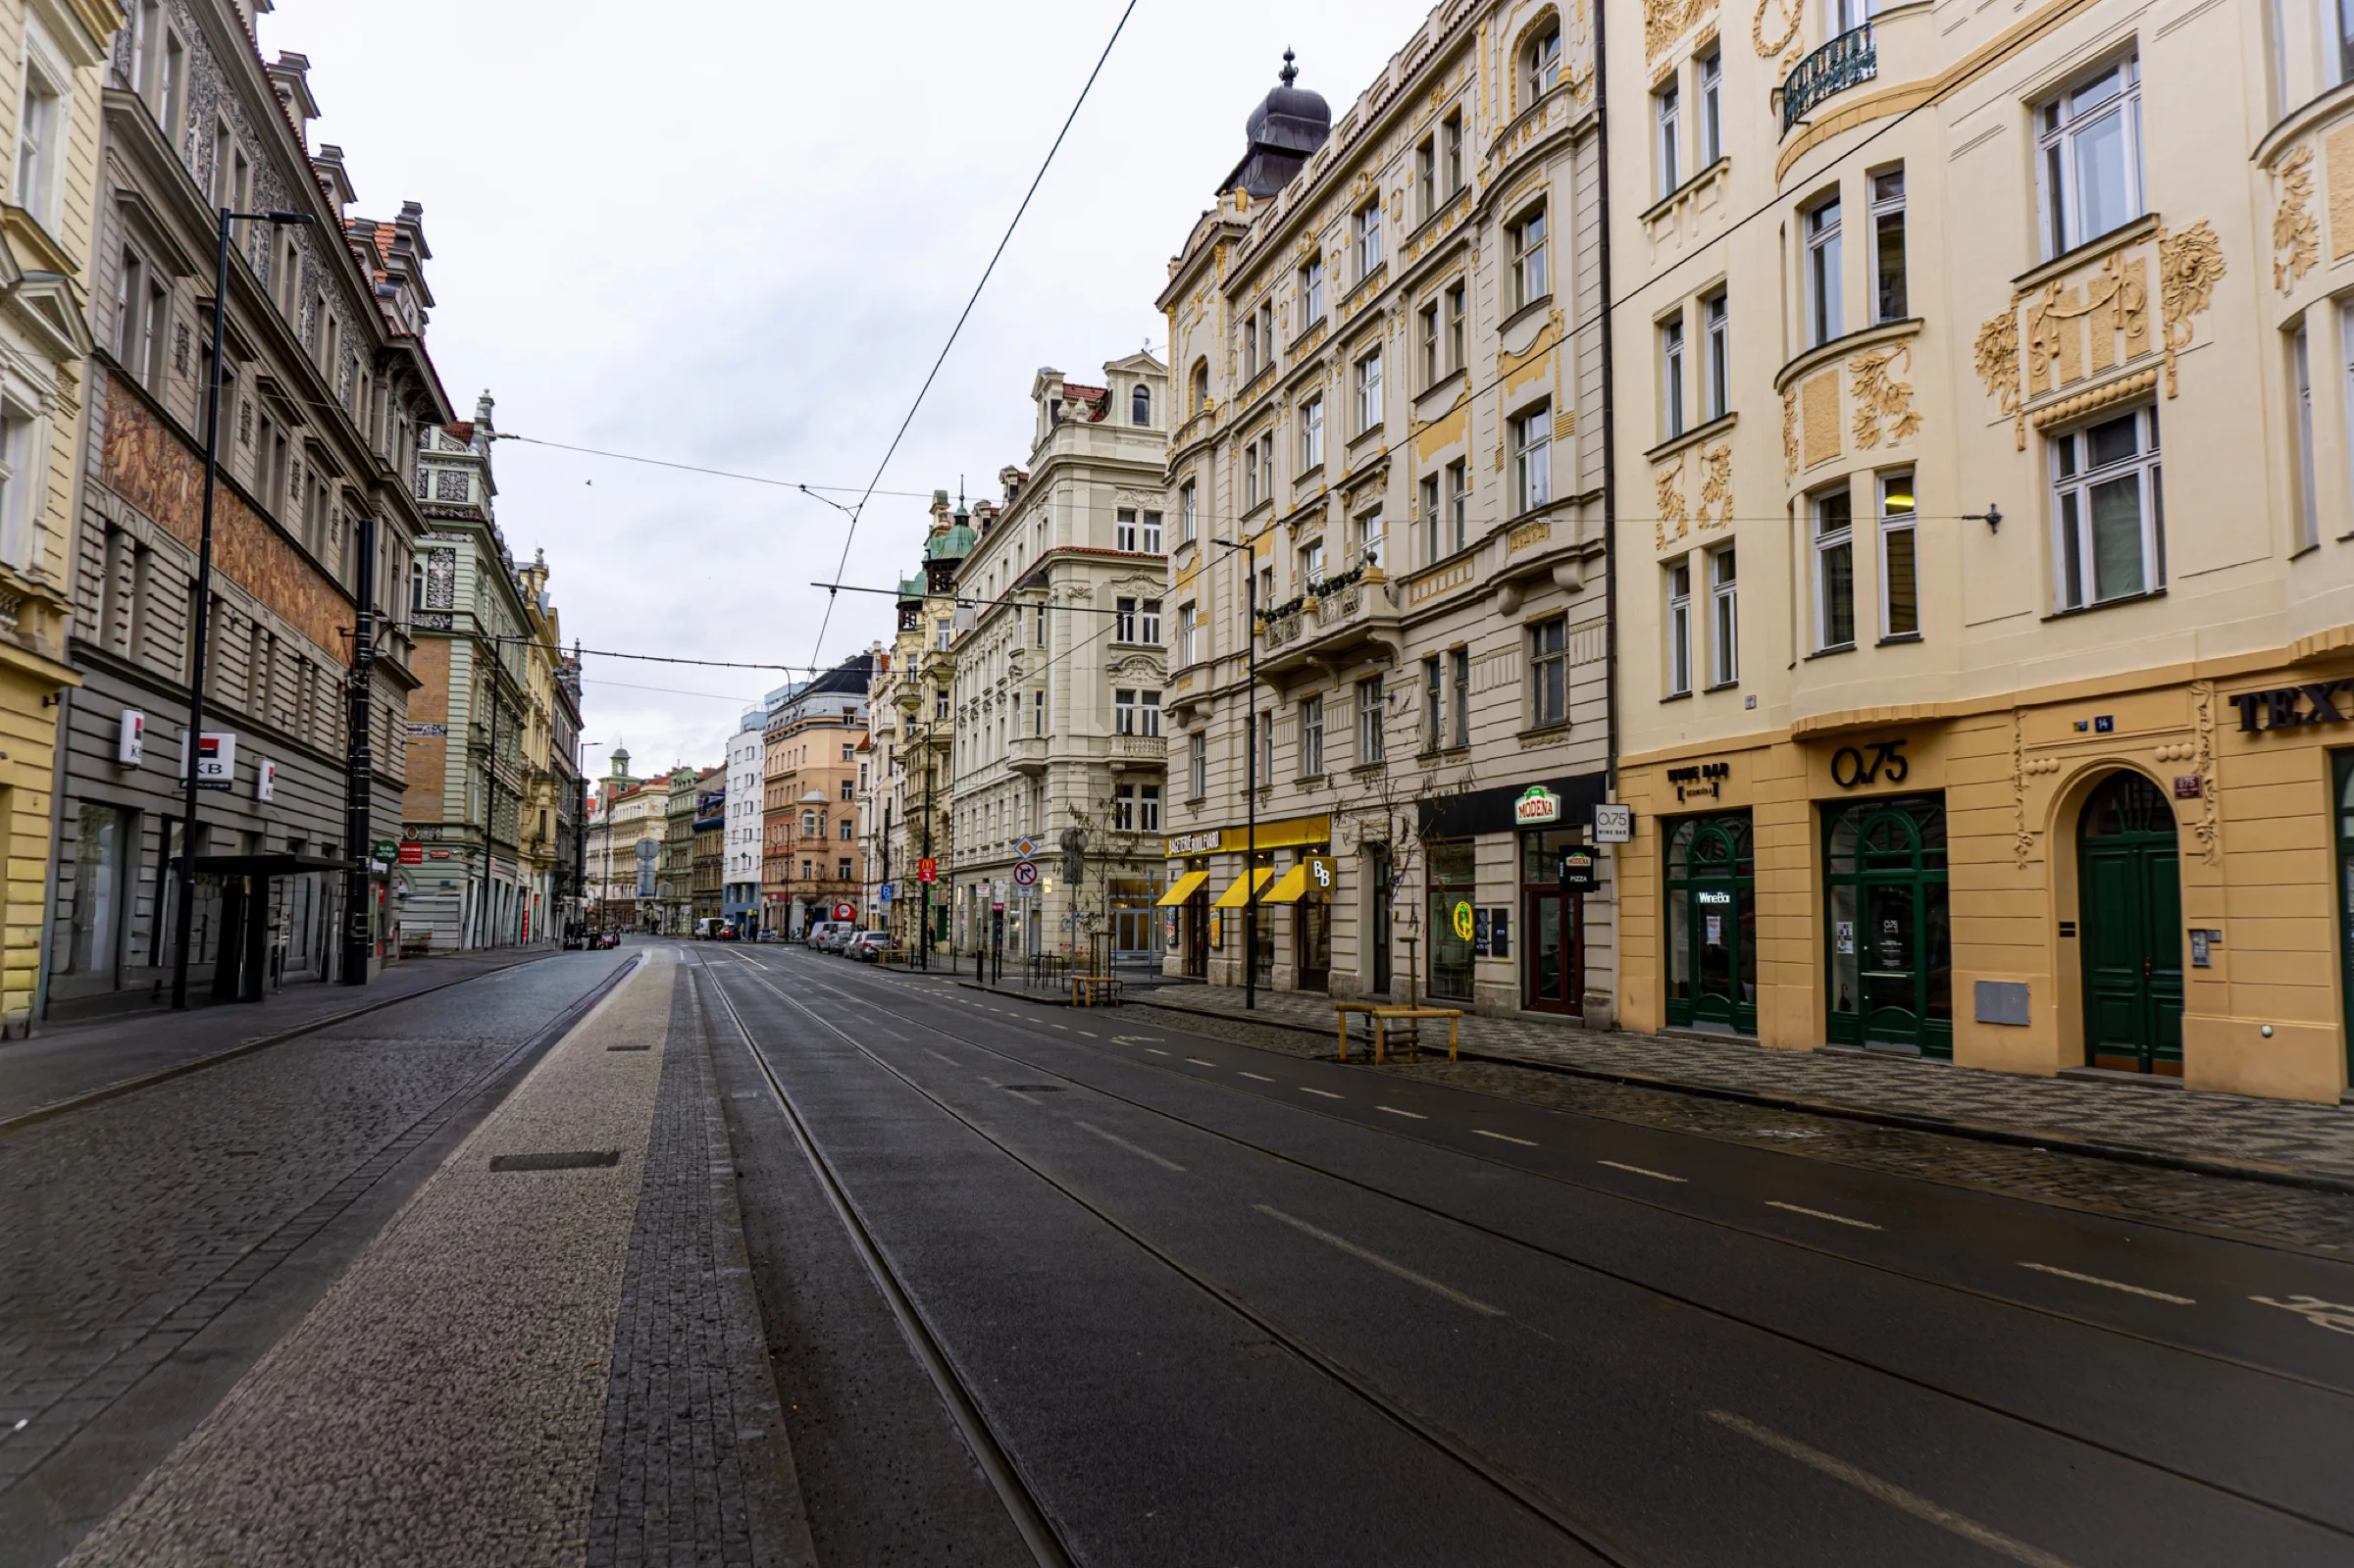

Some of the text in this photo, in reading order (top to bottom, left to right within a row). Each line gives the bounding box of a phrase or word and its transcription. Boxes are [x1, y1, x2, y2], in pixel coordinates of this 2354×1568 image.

[1666, 763, 1729, 783] WINE BAR
[1518, 799, 1553, 818] MODENA
